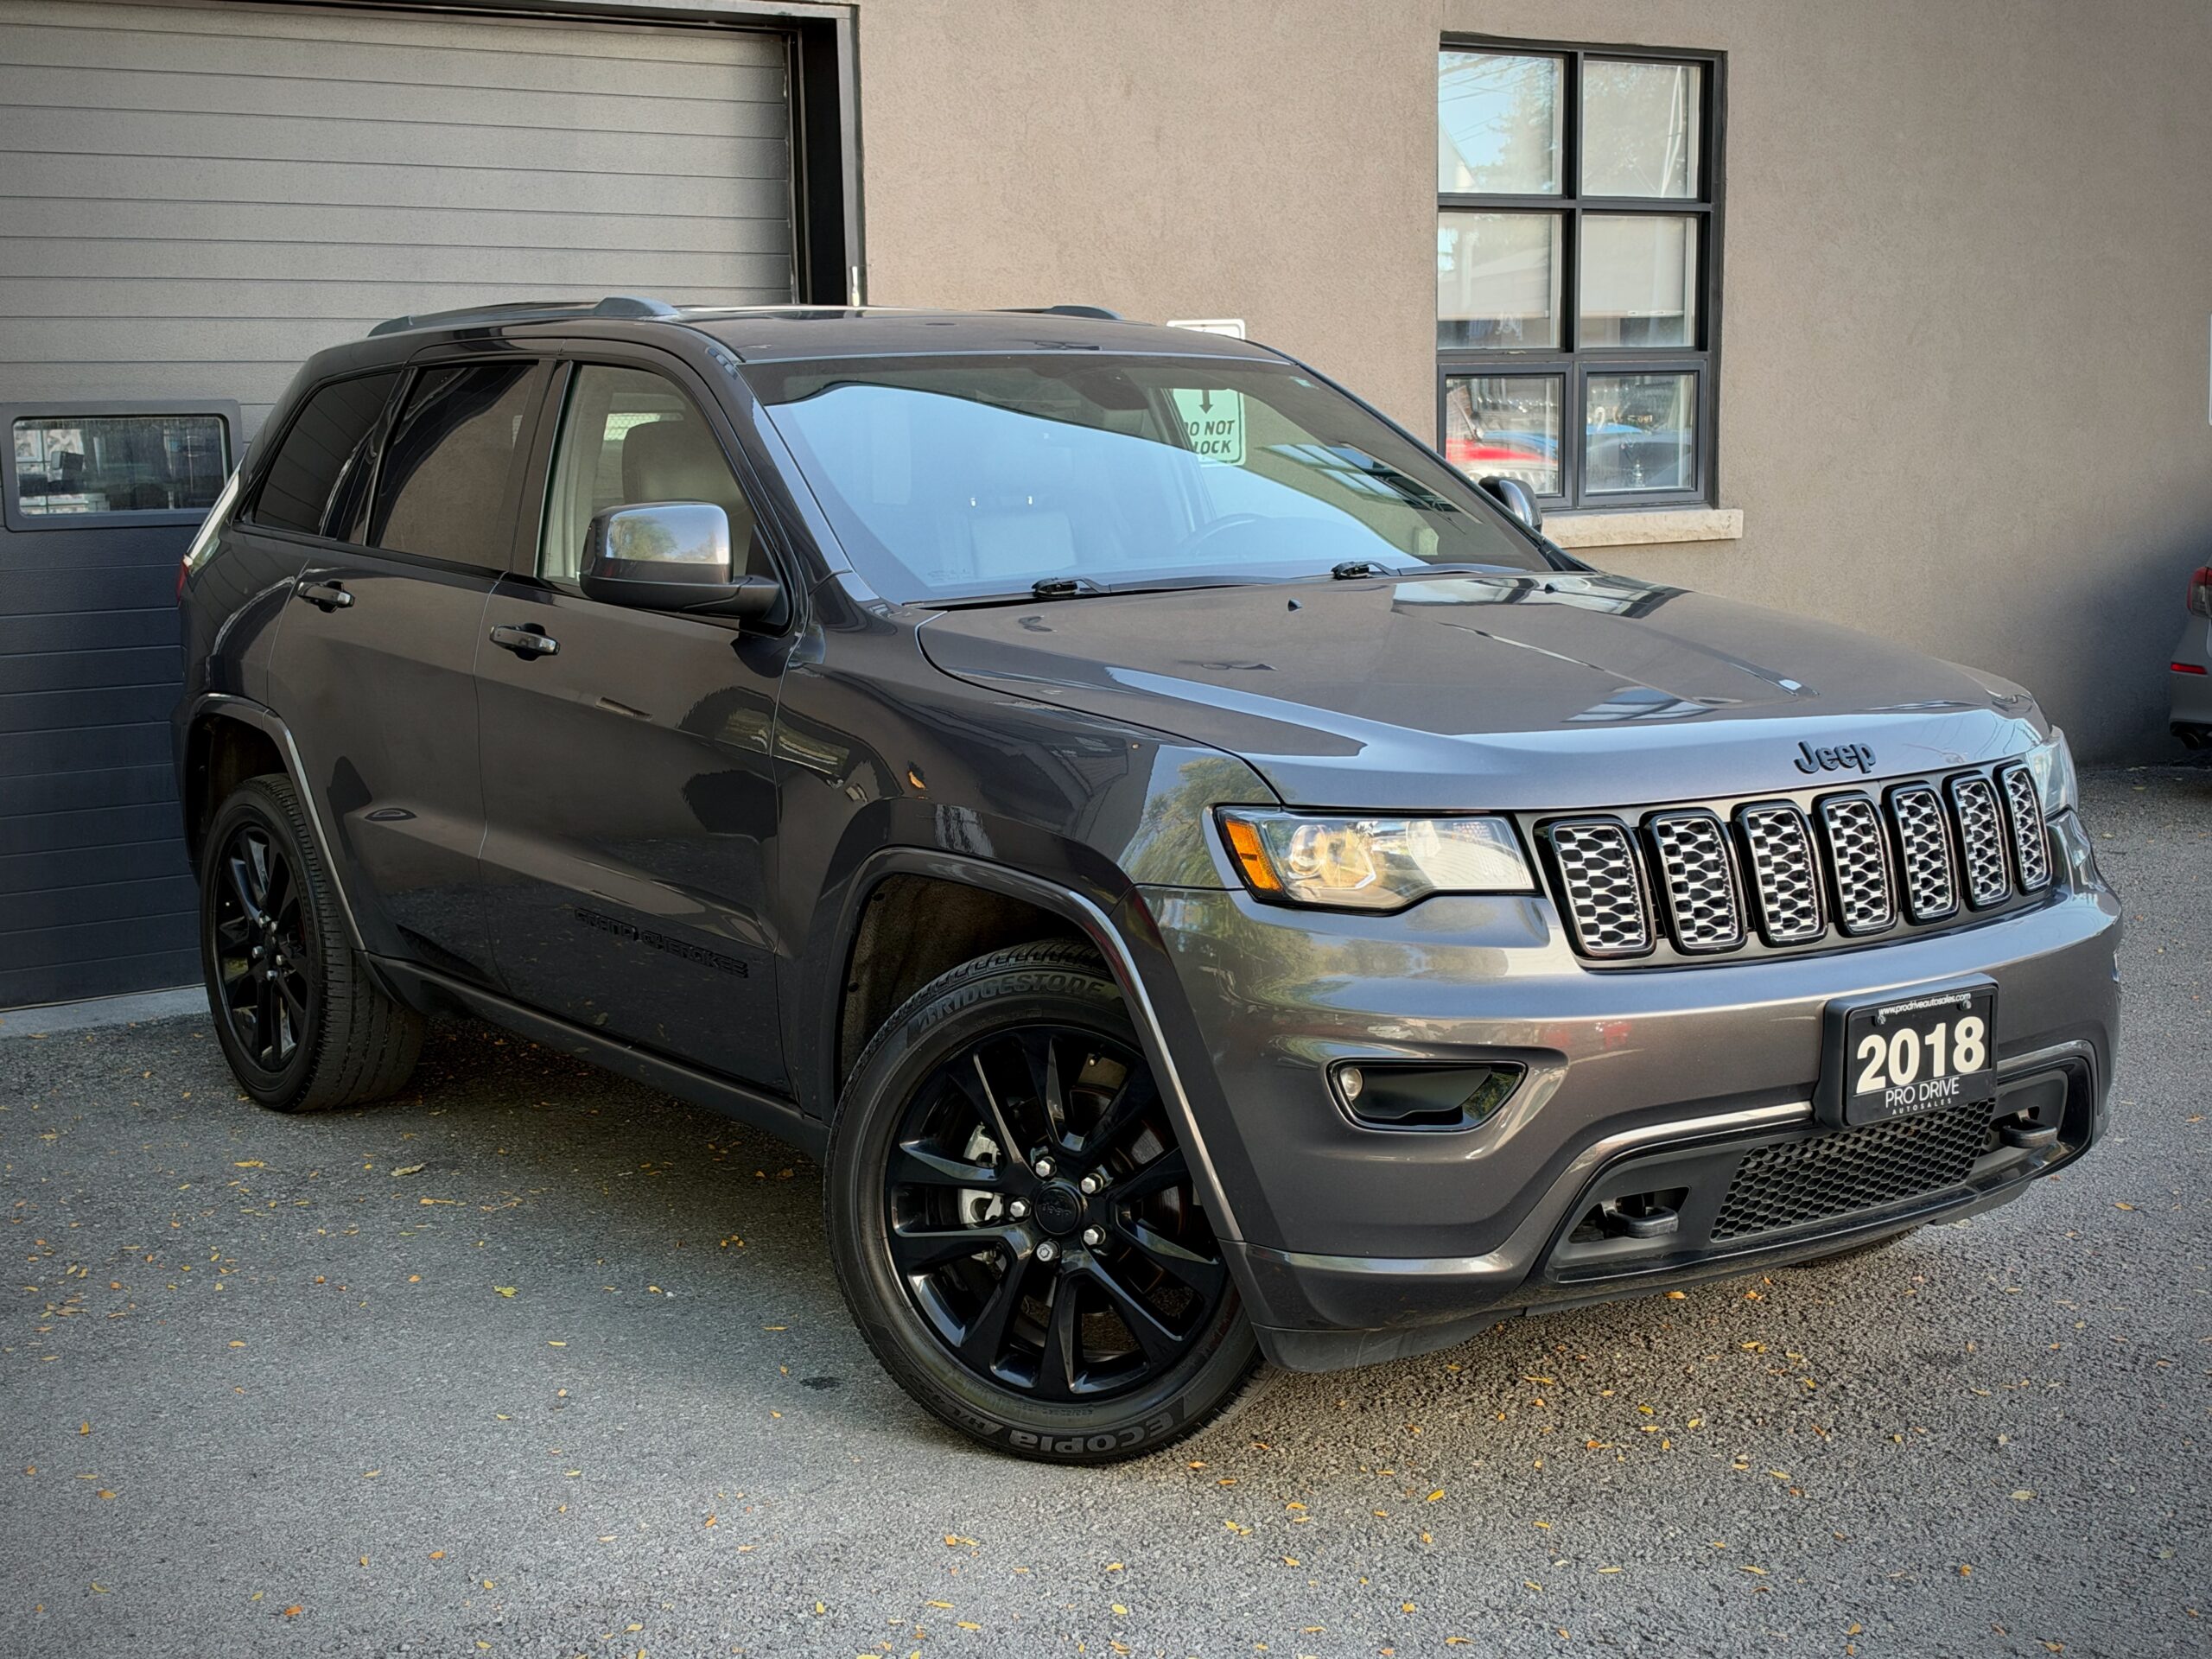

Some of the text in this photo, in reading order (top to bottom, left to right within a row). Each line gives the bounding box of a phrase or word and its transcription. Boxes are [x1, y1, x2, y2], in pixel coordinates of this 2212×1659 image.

[1204, 420, 1235, 435] NOT
[1794, 741, 1876, 774] Jeep
[918, 974, 1106, 1032] BRIDGESTONE
[1878, 993, 1971, 1016] www.prodriveautosales.com
[1856, 1016, 1985, 1093] 2018
[1885, 1077, 1960, 1108] PRO DRIVE
[1892, 1097, 1951, 1116] AUTOSALES
[1009, 1412, 1173, 1453] ECOPIA
